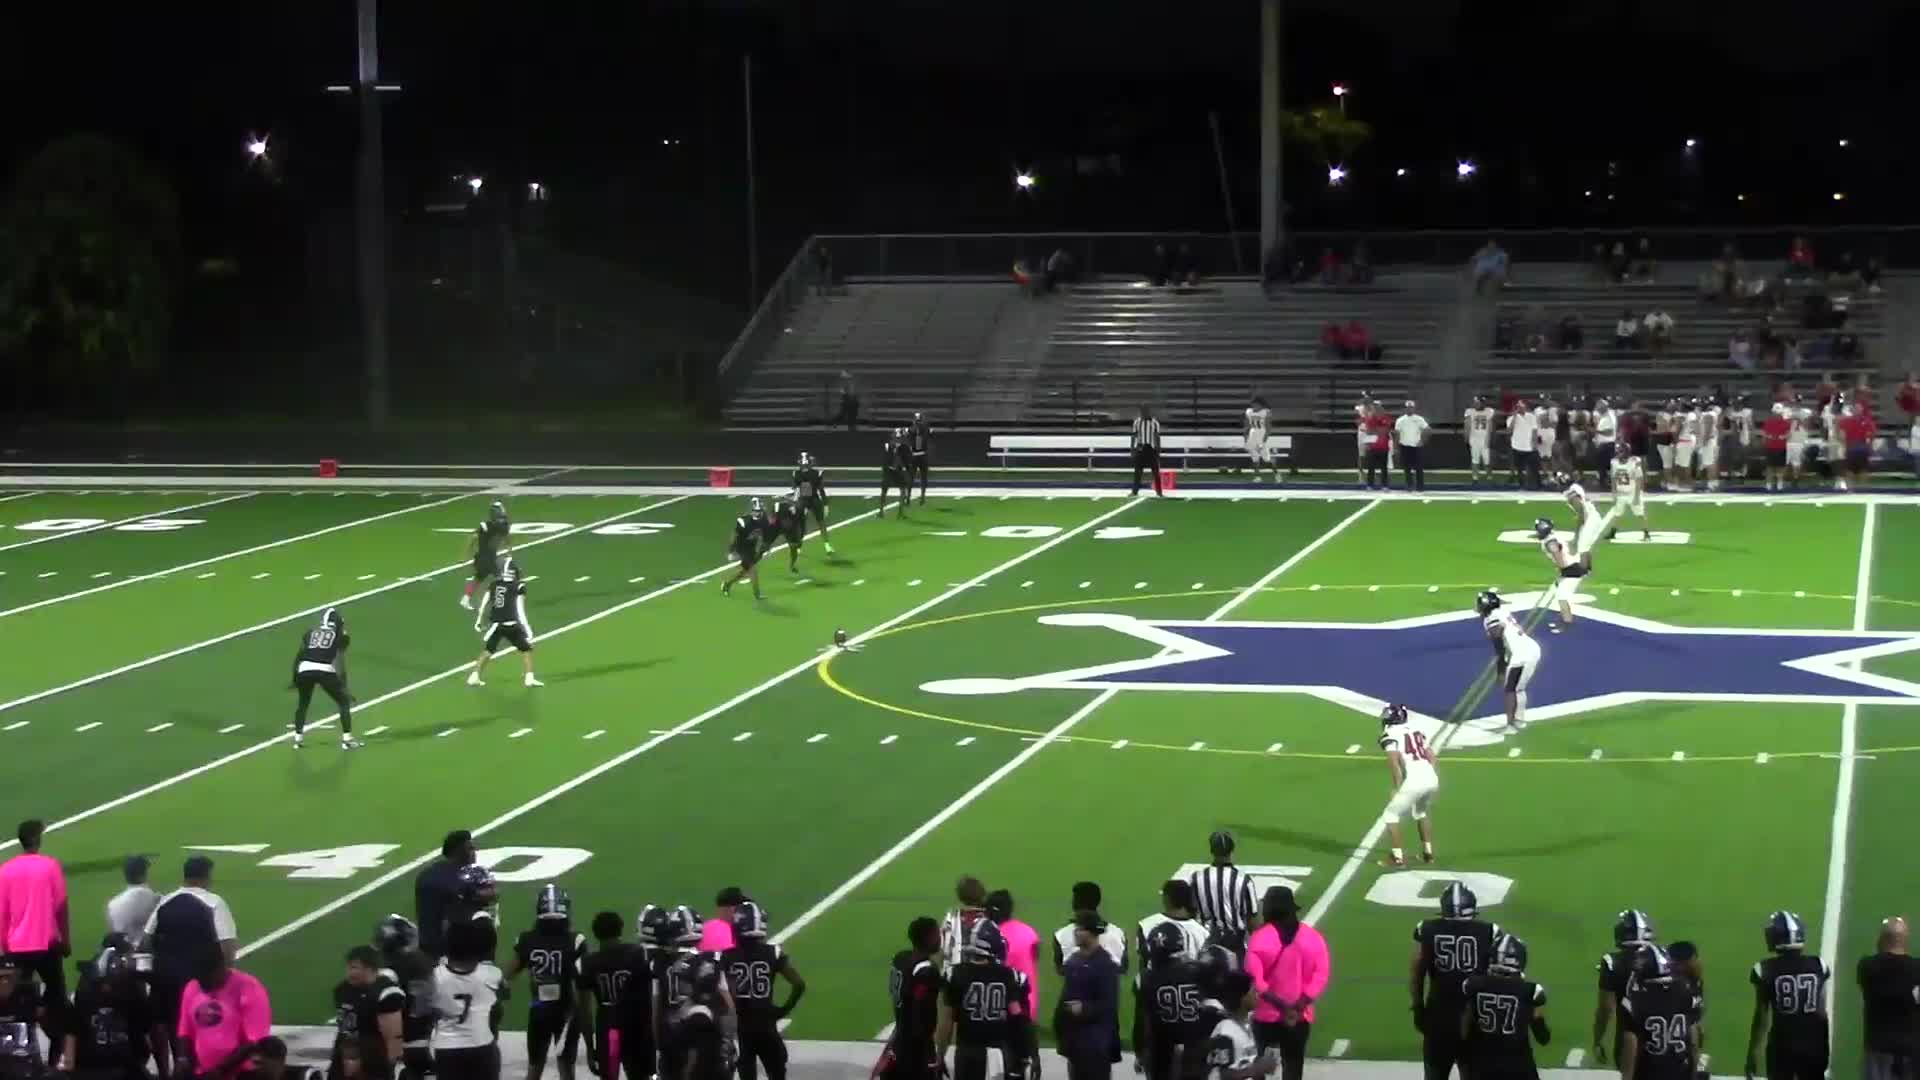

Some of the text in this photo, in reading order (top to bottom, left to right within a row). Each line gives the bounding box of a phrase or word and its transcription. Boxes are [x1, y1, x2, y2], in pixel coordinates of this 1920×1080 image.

[529, 949, 562, 976] 21
[1433, 934, 1478, 972] 50
[730, 960, 770, 999] 26
[1775, 973, 1818, 1014] 87
[454, 993, 472, 1024] 7
[963, 981, 1007, 1021] 40
[1156, 984, 1200, 1023] 95
[1476, 992, 1519, 1034] 57
[1644, 1013, 1687, 1054] 34
